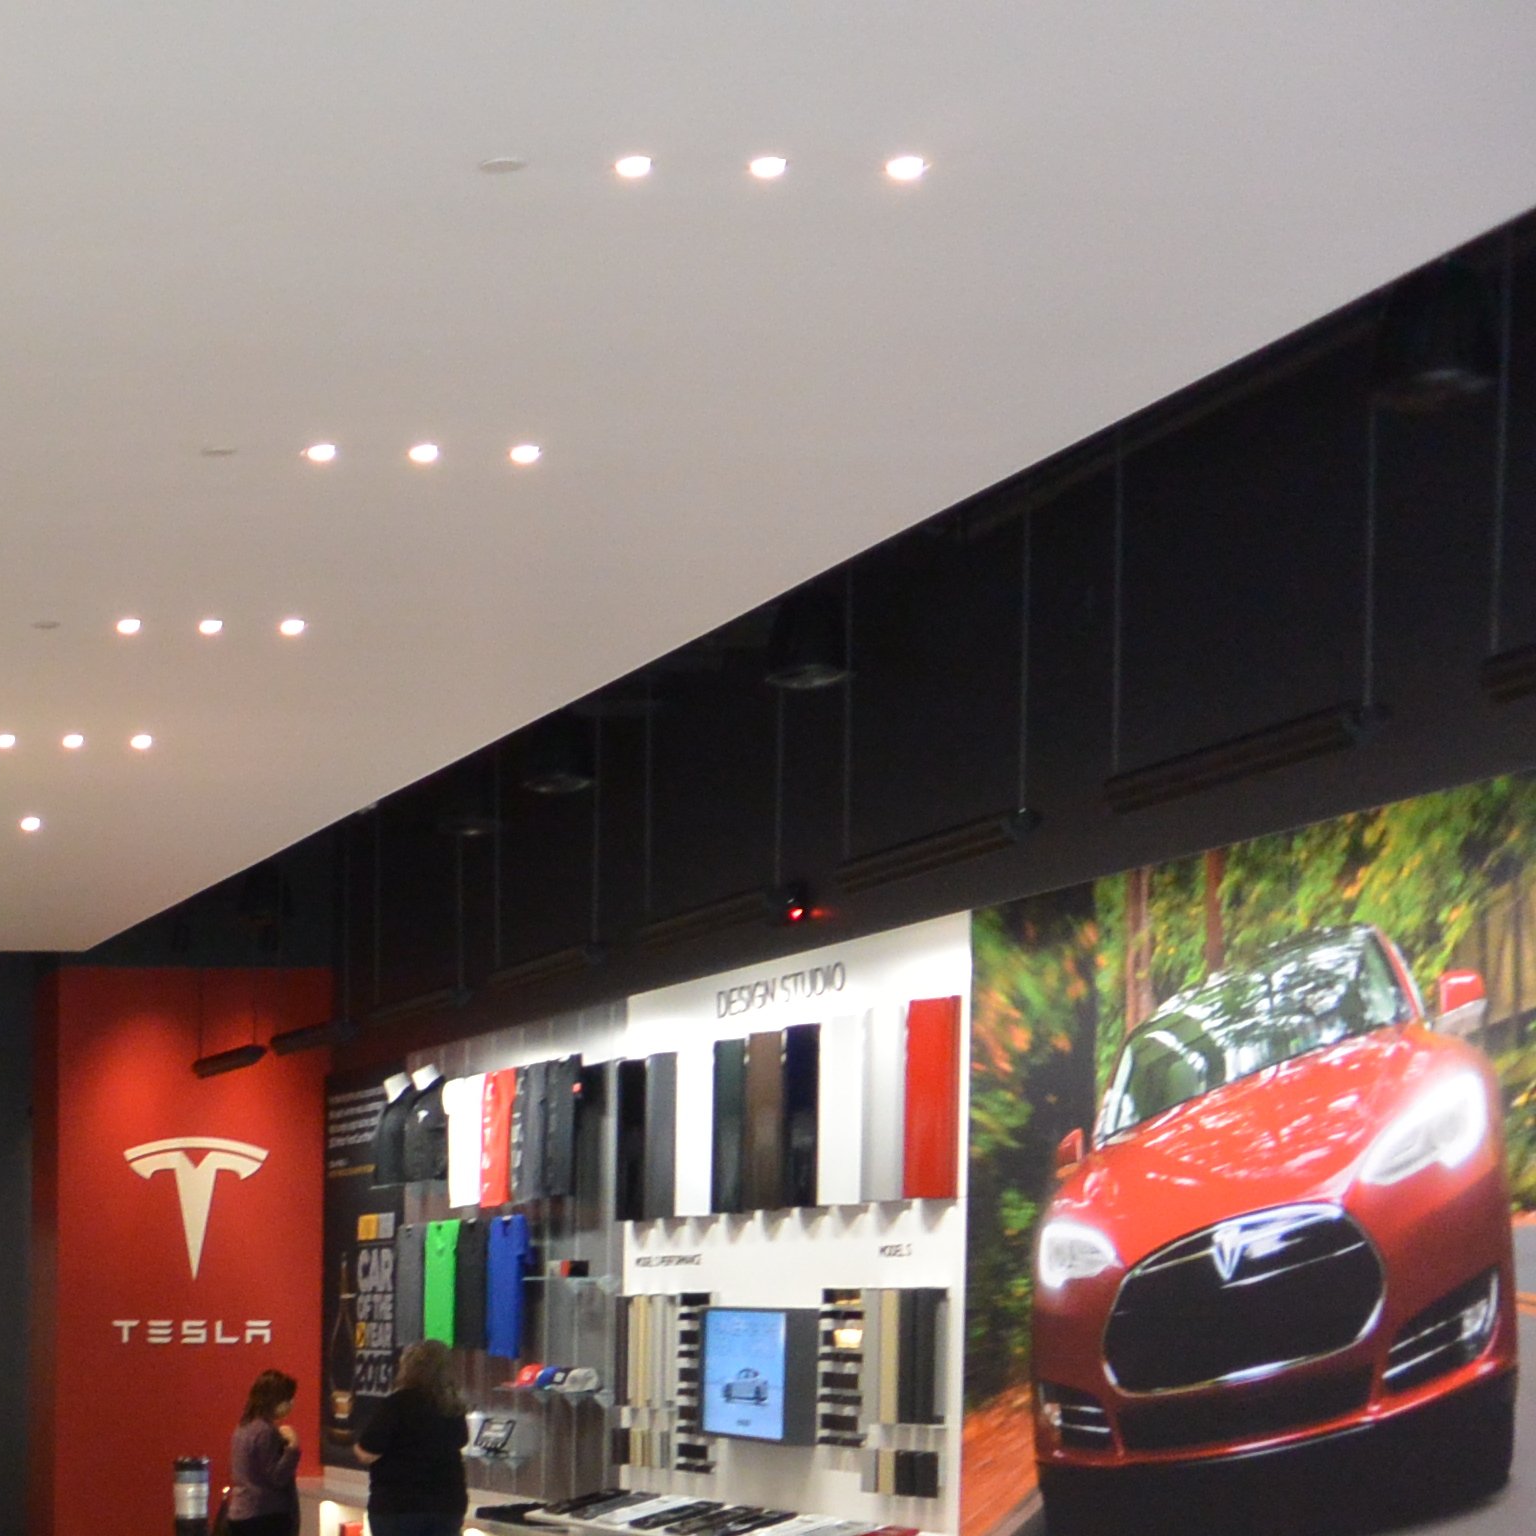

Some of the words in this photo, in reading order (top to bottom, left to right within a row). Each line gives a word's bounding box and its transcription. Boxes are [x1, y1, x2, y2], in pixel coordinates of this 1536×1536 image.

[716, 978, 777, 1019] DESIGN
[780, 961, 846, 1002] STUDIO
[880, 1243, 904, 1257] MODEL
[358, 1249, 393, 1292] CAR
[357, 1295, 371, 1321] OF
[373, 1293, 393, 1320] THE
[112, 1319, 273, 1344] TESLA
